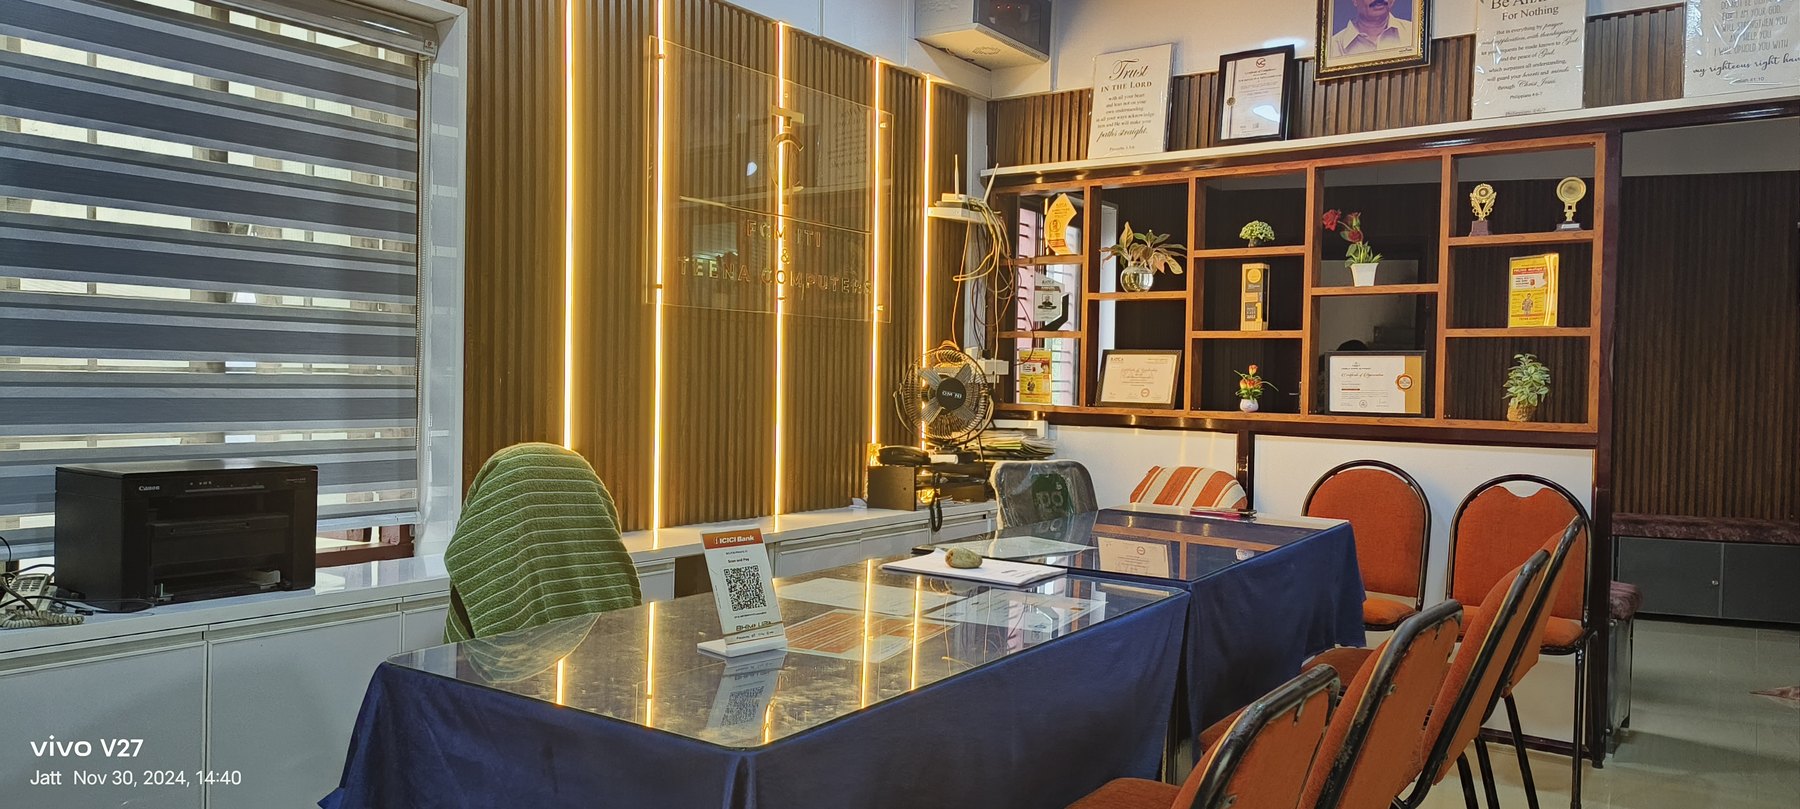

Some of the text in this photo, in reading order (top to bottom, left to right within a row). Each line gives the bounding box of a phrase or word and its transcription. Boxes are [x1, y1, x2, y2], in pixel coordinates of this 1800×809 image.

[1502, 6, 1560, 21] For Nothing
[1108, 58, 1149, 81] Trust
[1692, 68, 1706, 77] my
[1709, 60, 1750, 76] righteous
[1754, 55, 1780, 71] right
[1112, 83, 1128, 91] THE
[1129, 81, 1153, 89] LORD
[796, 228, 823, 248] ITI
[780, 248, 791, 265] &
[677, 256, 872, 295] TEENA COMPUTERS
[737, 535, 755, 543] Bank
